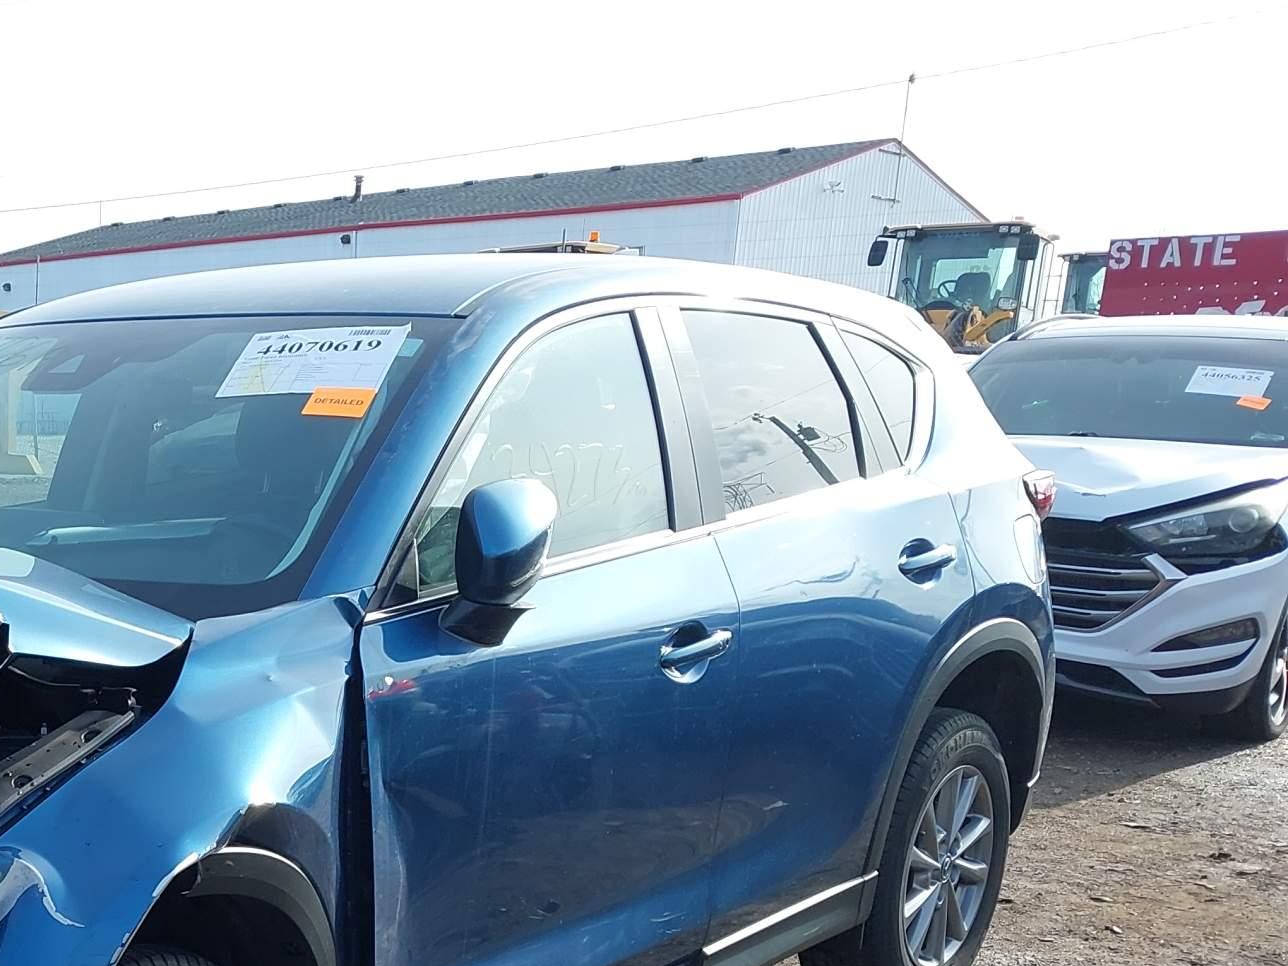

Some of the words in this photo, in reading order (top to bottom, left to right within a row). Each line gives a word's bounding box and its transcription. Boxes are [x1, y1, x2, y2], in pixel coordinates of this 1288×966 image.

[1108, 235, 1241, 269] STATE
[257, 339, 383, 357] 44070619
[313, 396, 365, 407] DETAILED
